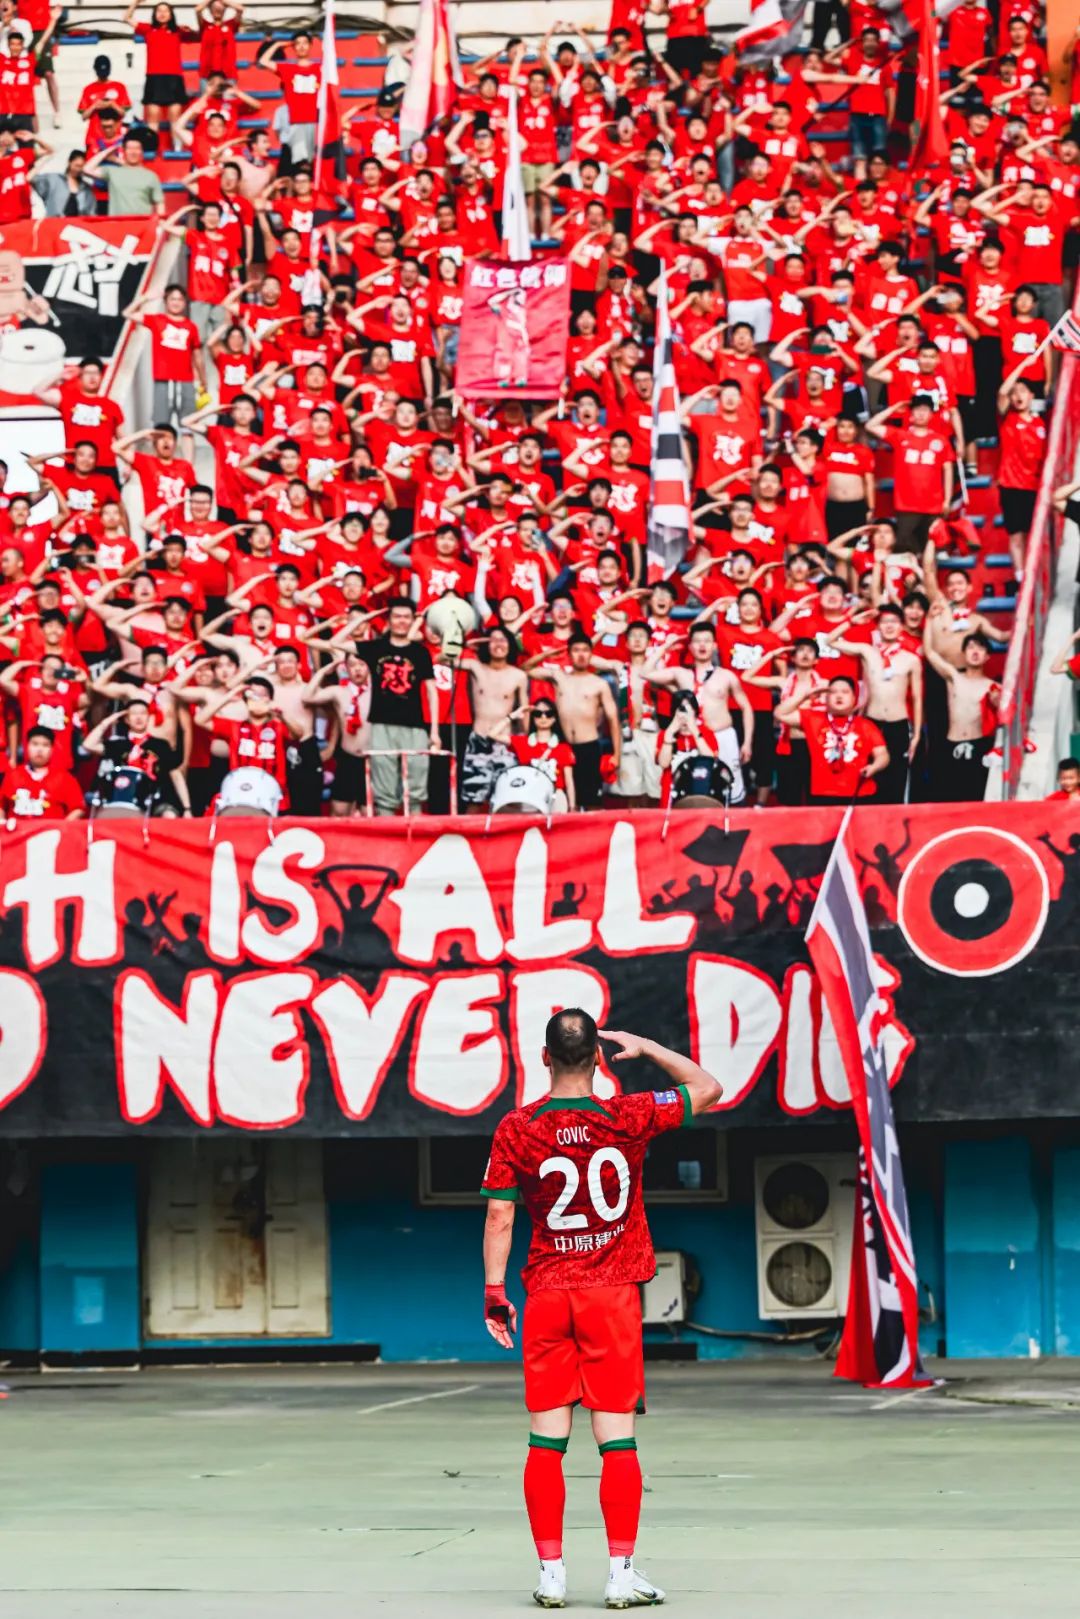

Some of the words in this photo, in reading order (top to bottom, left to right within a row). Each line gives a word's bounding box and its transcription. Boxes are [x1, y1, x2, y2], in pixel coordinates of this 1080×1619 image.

[207, 827, 326, 963] IS
[391, 821, 697, 963] ALL
[116, 966, 618, 1127] NEVER
[539, 1147, 631, 1230] 20
[556, 1126, 591, 1146] COVIC
